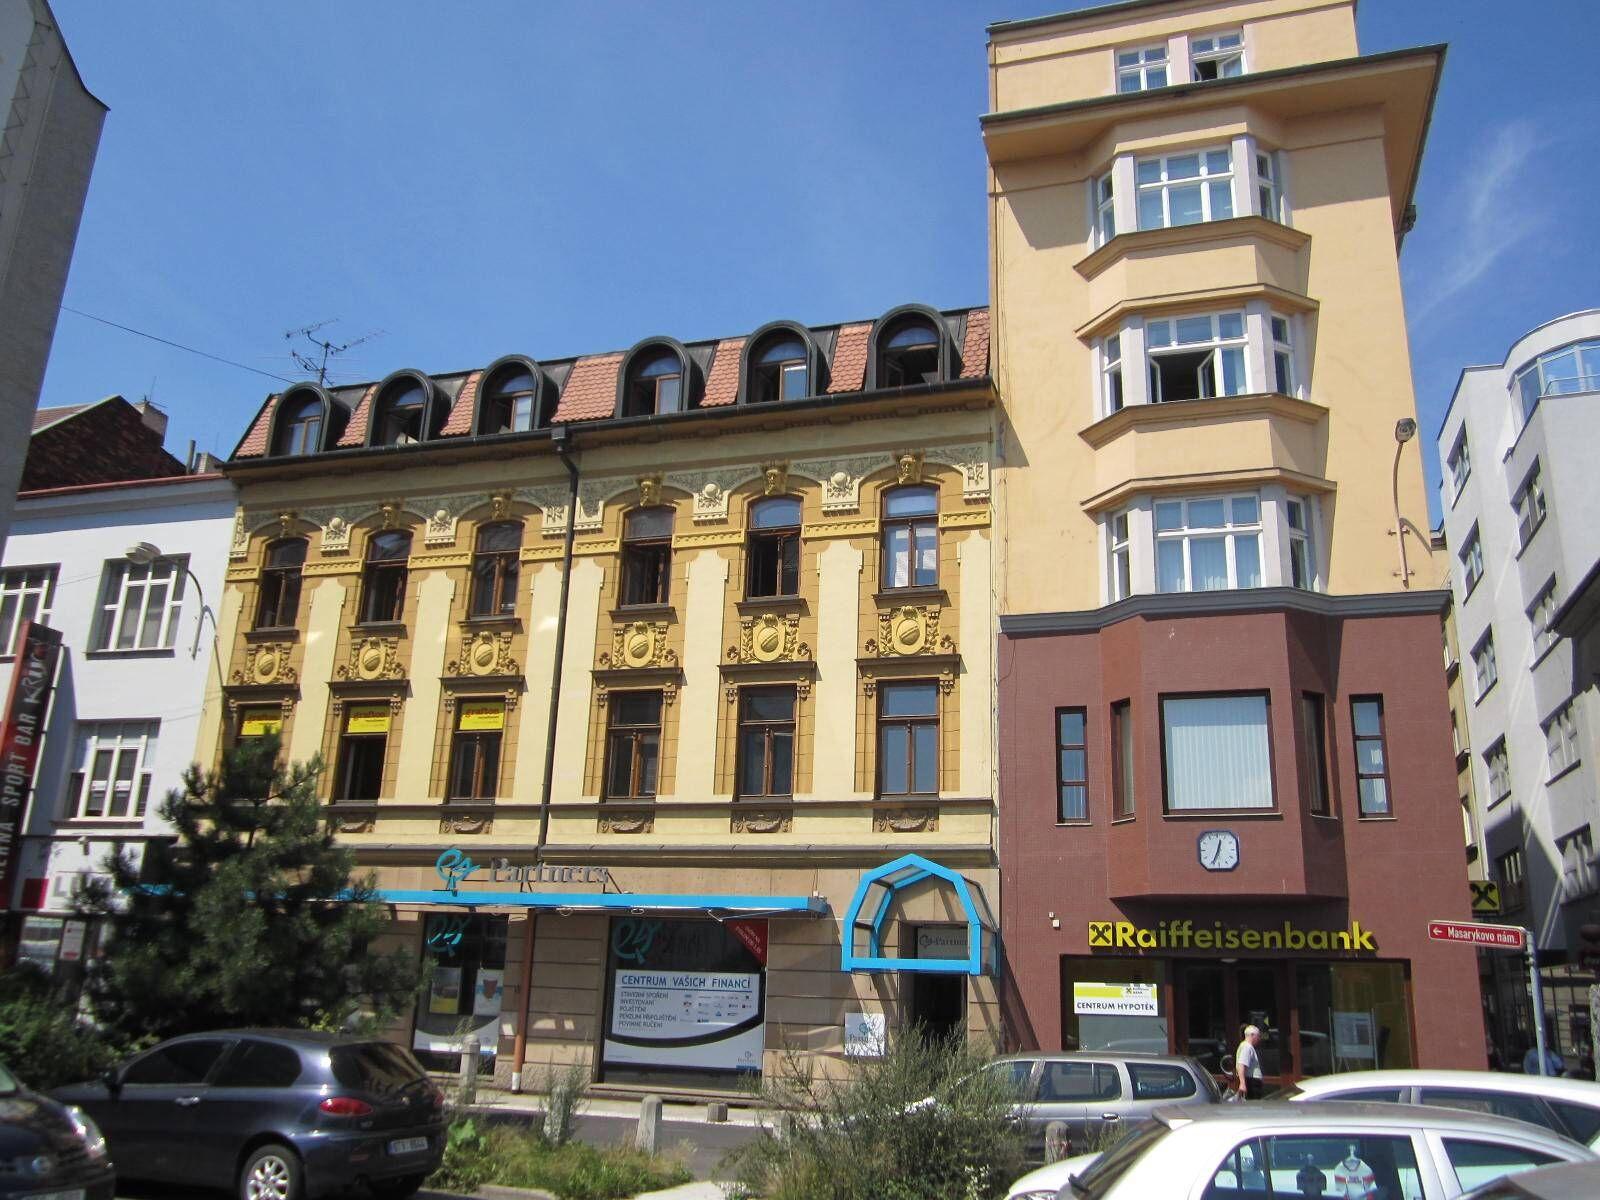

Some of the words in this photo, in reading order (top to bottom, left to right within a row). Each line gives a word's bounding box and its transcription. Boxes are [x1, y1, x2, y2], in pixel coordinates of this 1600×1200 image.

[2, 751, 28, 807] SPORT
[15, 713, 38, 747] BAR
[489, 857, 609, 883] Partners
[1115, 920, 1376, 950] Raiffeisenbank
[1447, 926, 1496, 942] Masarykovo
[1497, 931, 1518, 944] nám.
[621, 975, 667, 987] CENTRUM
[672, 974, 706, 988] VAŠICH
[711, 976, 751, 989] FINANCÍ
[1076, 1001, 1115, 1009] CENTRUM
